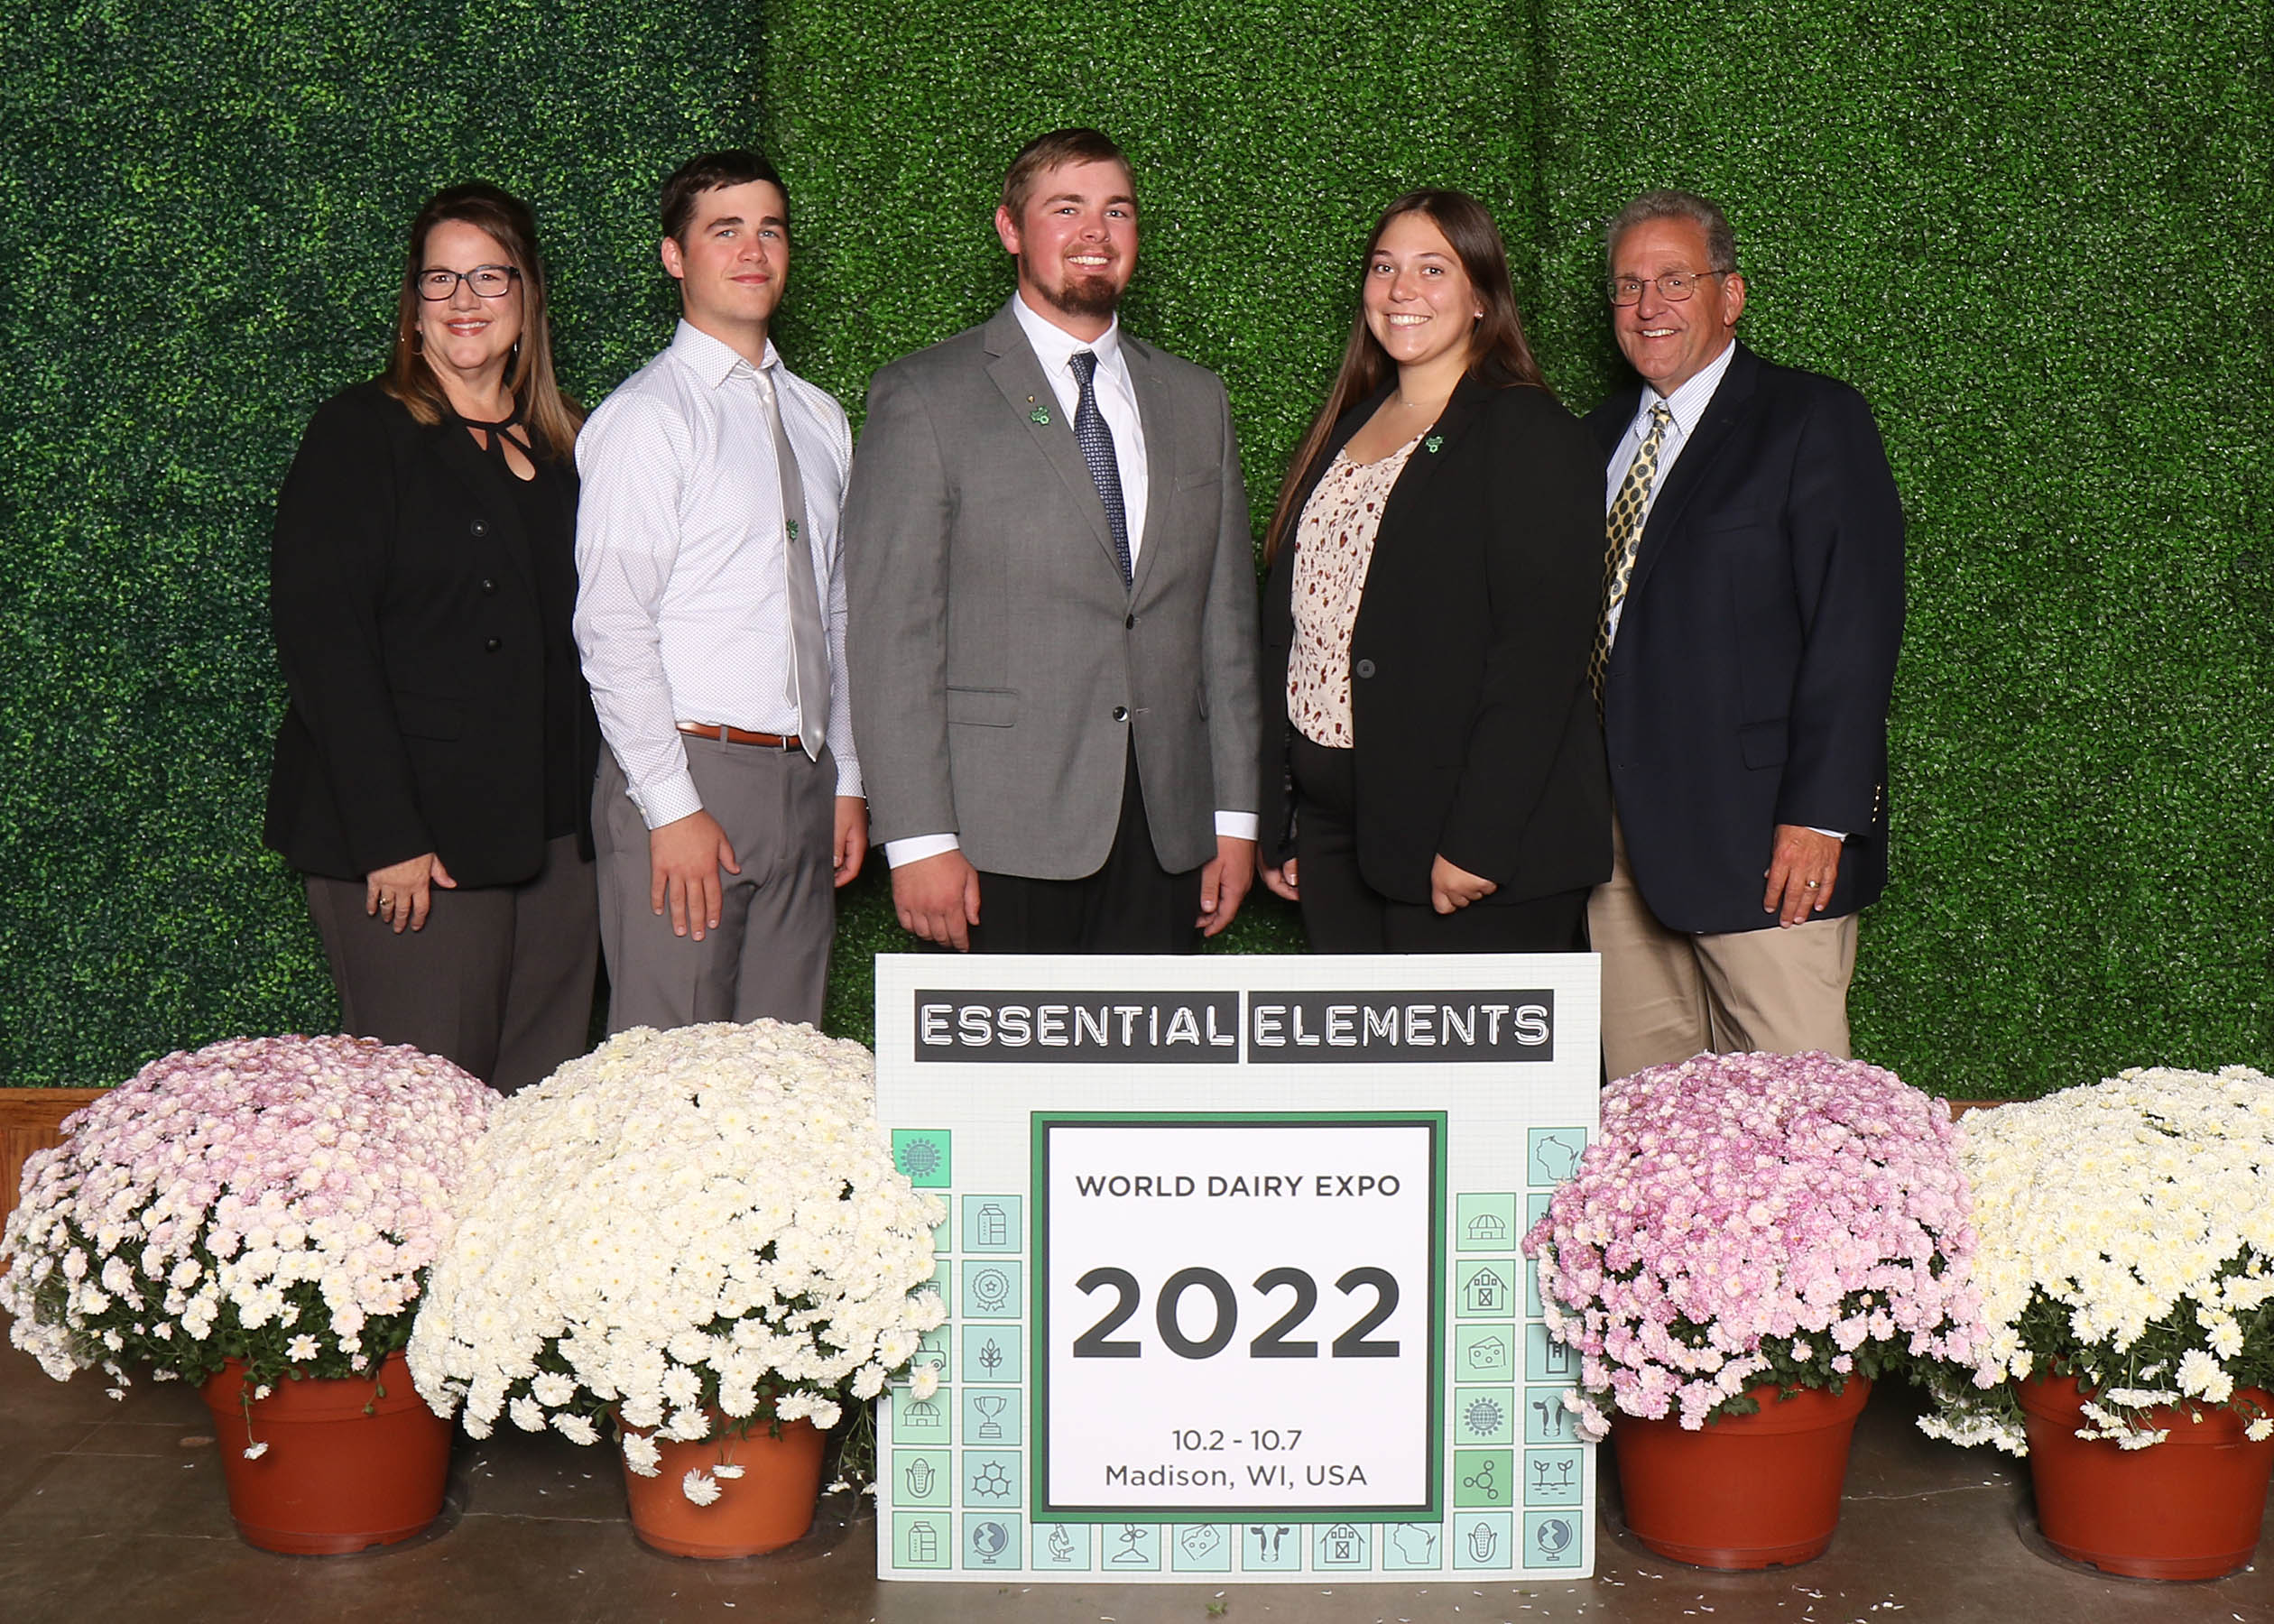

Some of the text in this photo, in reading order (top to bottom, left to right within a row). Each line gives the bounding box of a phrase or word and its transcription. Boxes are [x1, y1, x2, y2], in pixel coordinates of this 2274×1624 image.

[919, 1003, 1550, 1047] ESSENTIAL ELEMENTS
[1076, 1175, 1400, 1197] WORLD DAIRY EXPO
[1073, 1266, 1400, 1360] 2022
[1172, 1429, 1225, 1451] 10.2
[1251, 1429, 1302, 1451] 10.7
[1106, 1464, 1367, 1489] Madison, WI, USA
